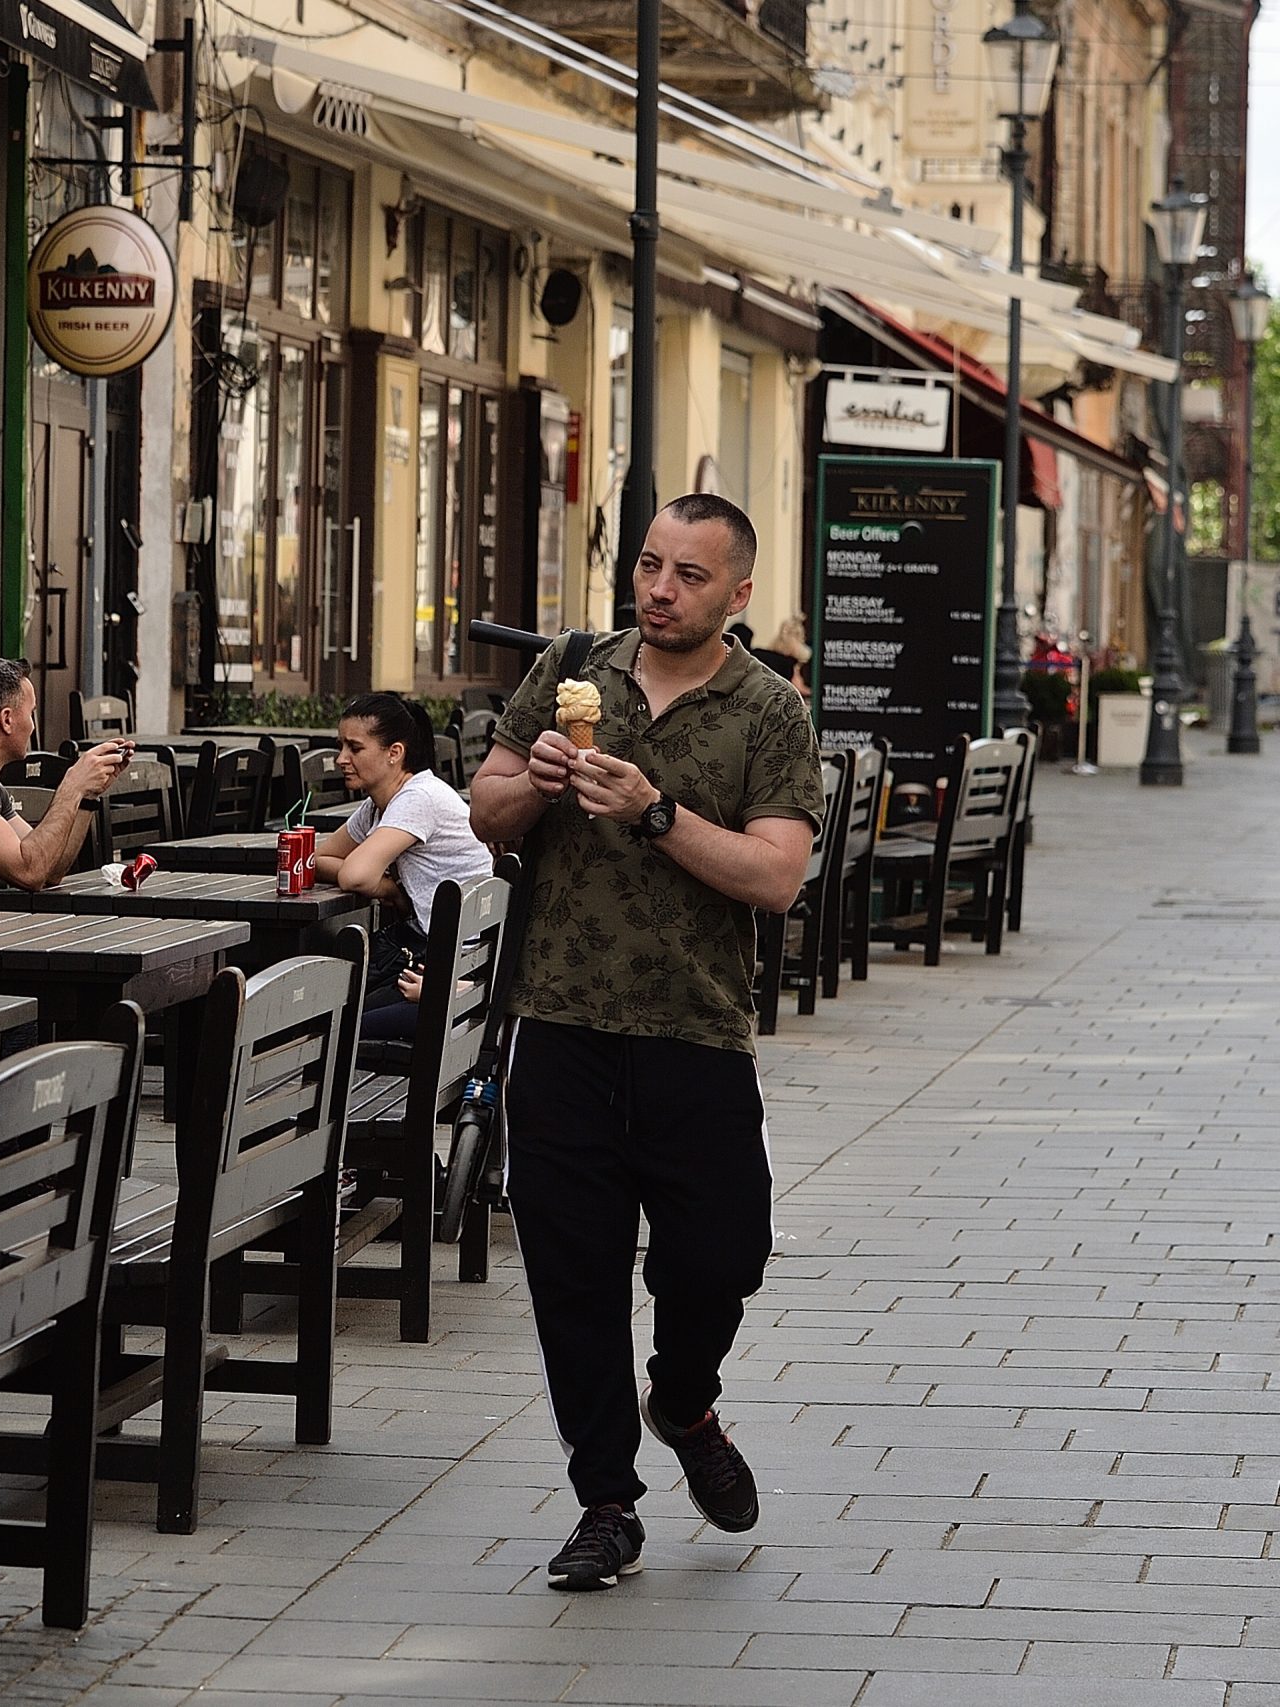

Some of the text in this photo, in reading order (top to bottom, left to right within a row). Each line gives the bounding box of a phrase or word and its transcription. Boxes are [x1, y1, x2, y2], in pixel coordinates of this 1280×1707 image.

[47, 279, 150, 301] KILKENNY
[58, 321, 129, 331] IRISH BEER
[844, 399, 939, 427] emilia
[857, 495, 960, 512] KILKENNY
[830, 524, 901, 543] Beer Offers
[826, 551, 881, 563] MONDAY
[903, 564, 939, 575] GRATIS
[826, 595, 884, 608] TUESDAY
[824, 640, 904, 654] WEDNESDAY
[823, 684, 891, 698] THURSDAY
[821, 729, 873, 742] SUNDAY
[32, 1071, 67, 1113] TUBORG
